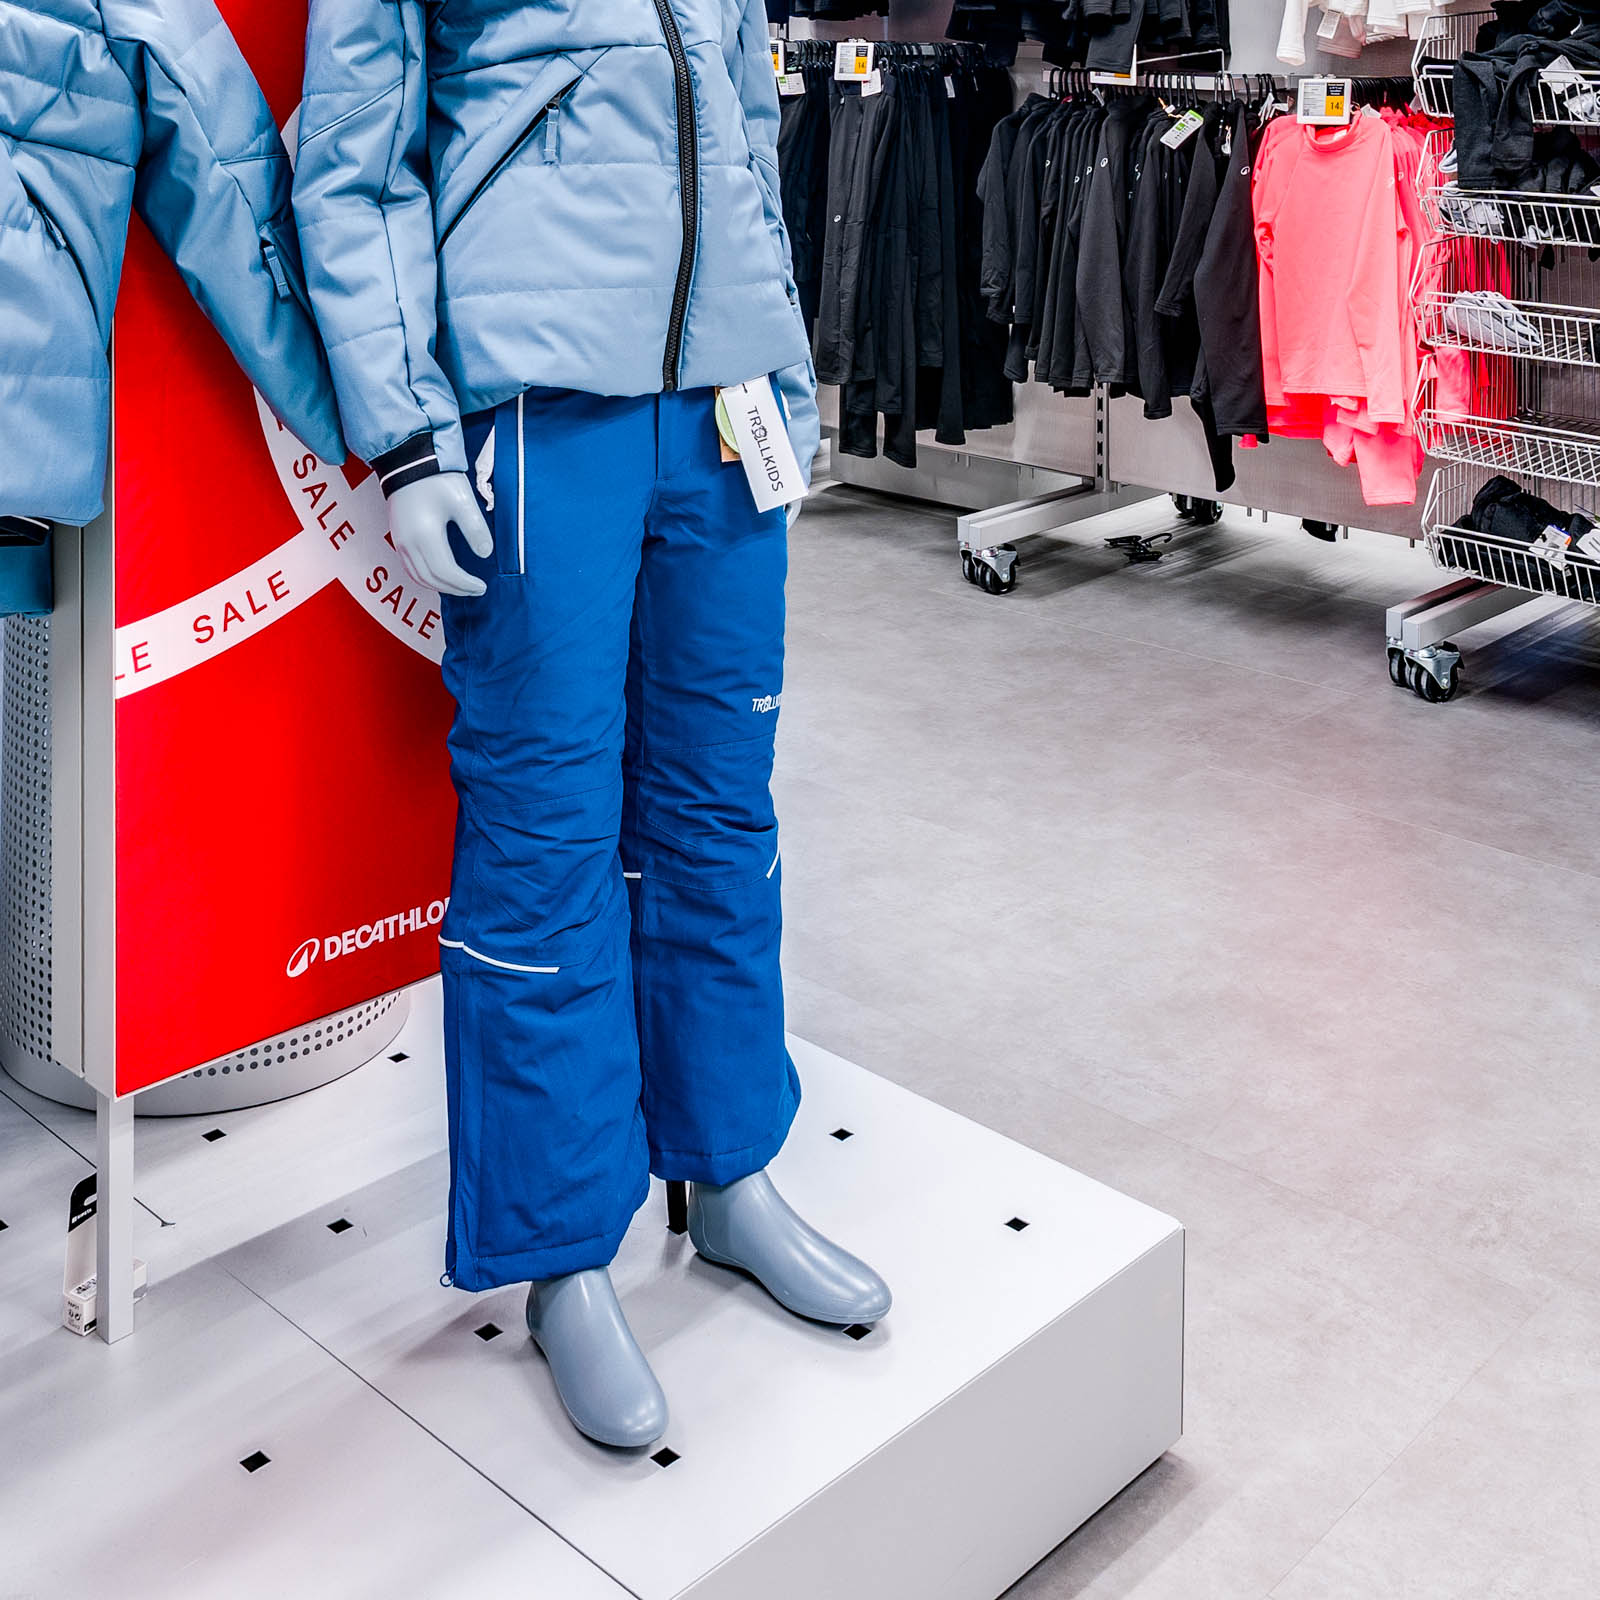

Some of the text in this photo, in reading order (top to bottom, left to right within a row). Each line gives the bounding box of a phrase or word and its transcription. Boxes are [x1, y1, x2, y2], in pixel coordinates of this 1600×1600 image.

[745, 404, 784, 492] TROLLKIDS
[293, 453, 355, 551] SALE
[192, 569, 291, 644] SALE
[365, 565, 441, 639] SALE
